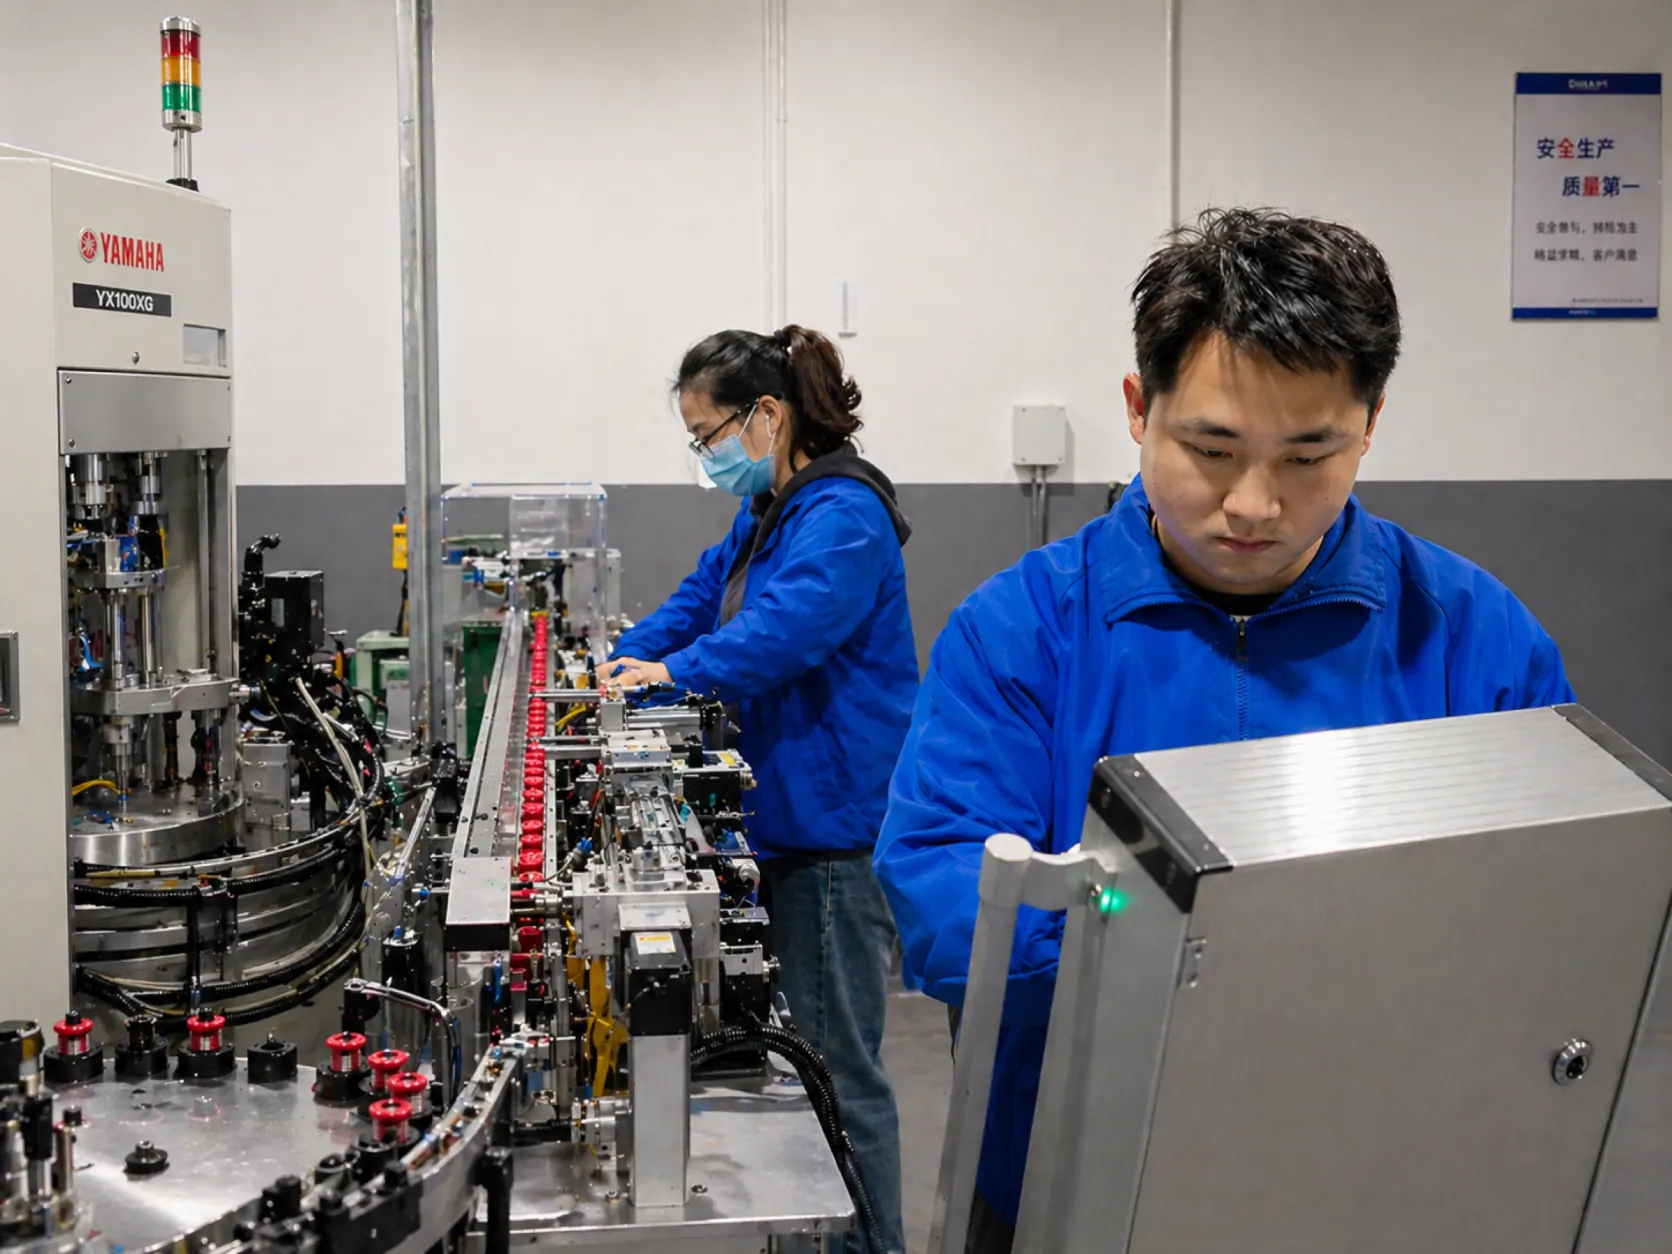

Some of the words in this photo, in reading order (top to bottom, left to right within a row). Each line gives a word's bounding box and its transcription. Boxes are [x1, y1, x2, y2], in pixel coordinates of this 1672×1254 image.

[1537, 138, 1615, 159] 安全生产
[1562, 175, 1640, 197] 质量第一
[100, 232, 164, 272] YAMAHA
[96, 289, 153, 312] YX100XG
